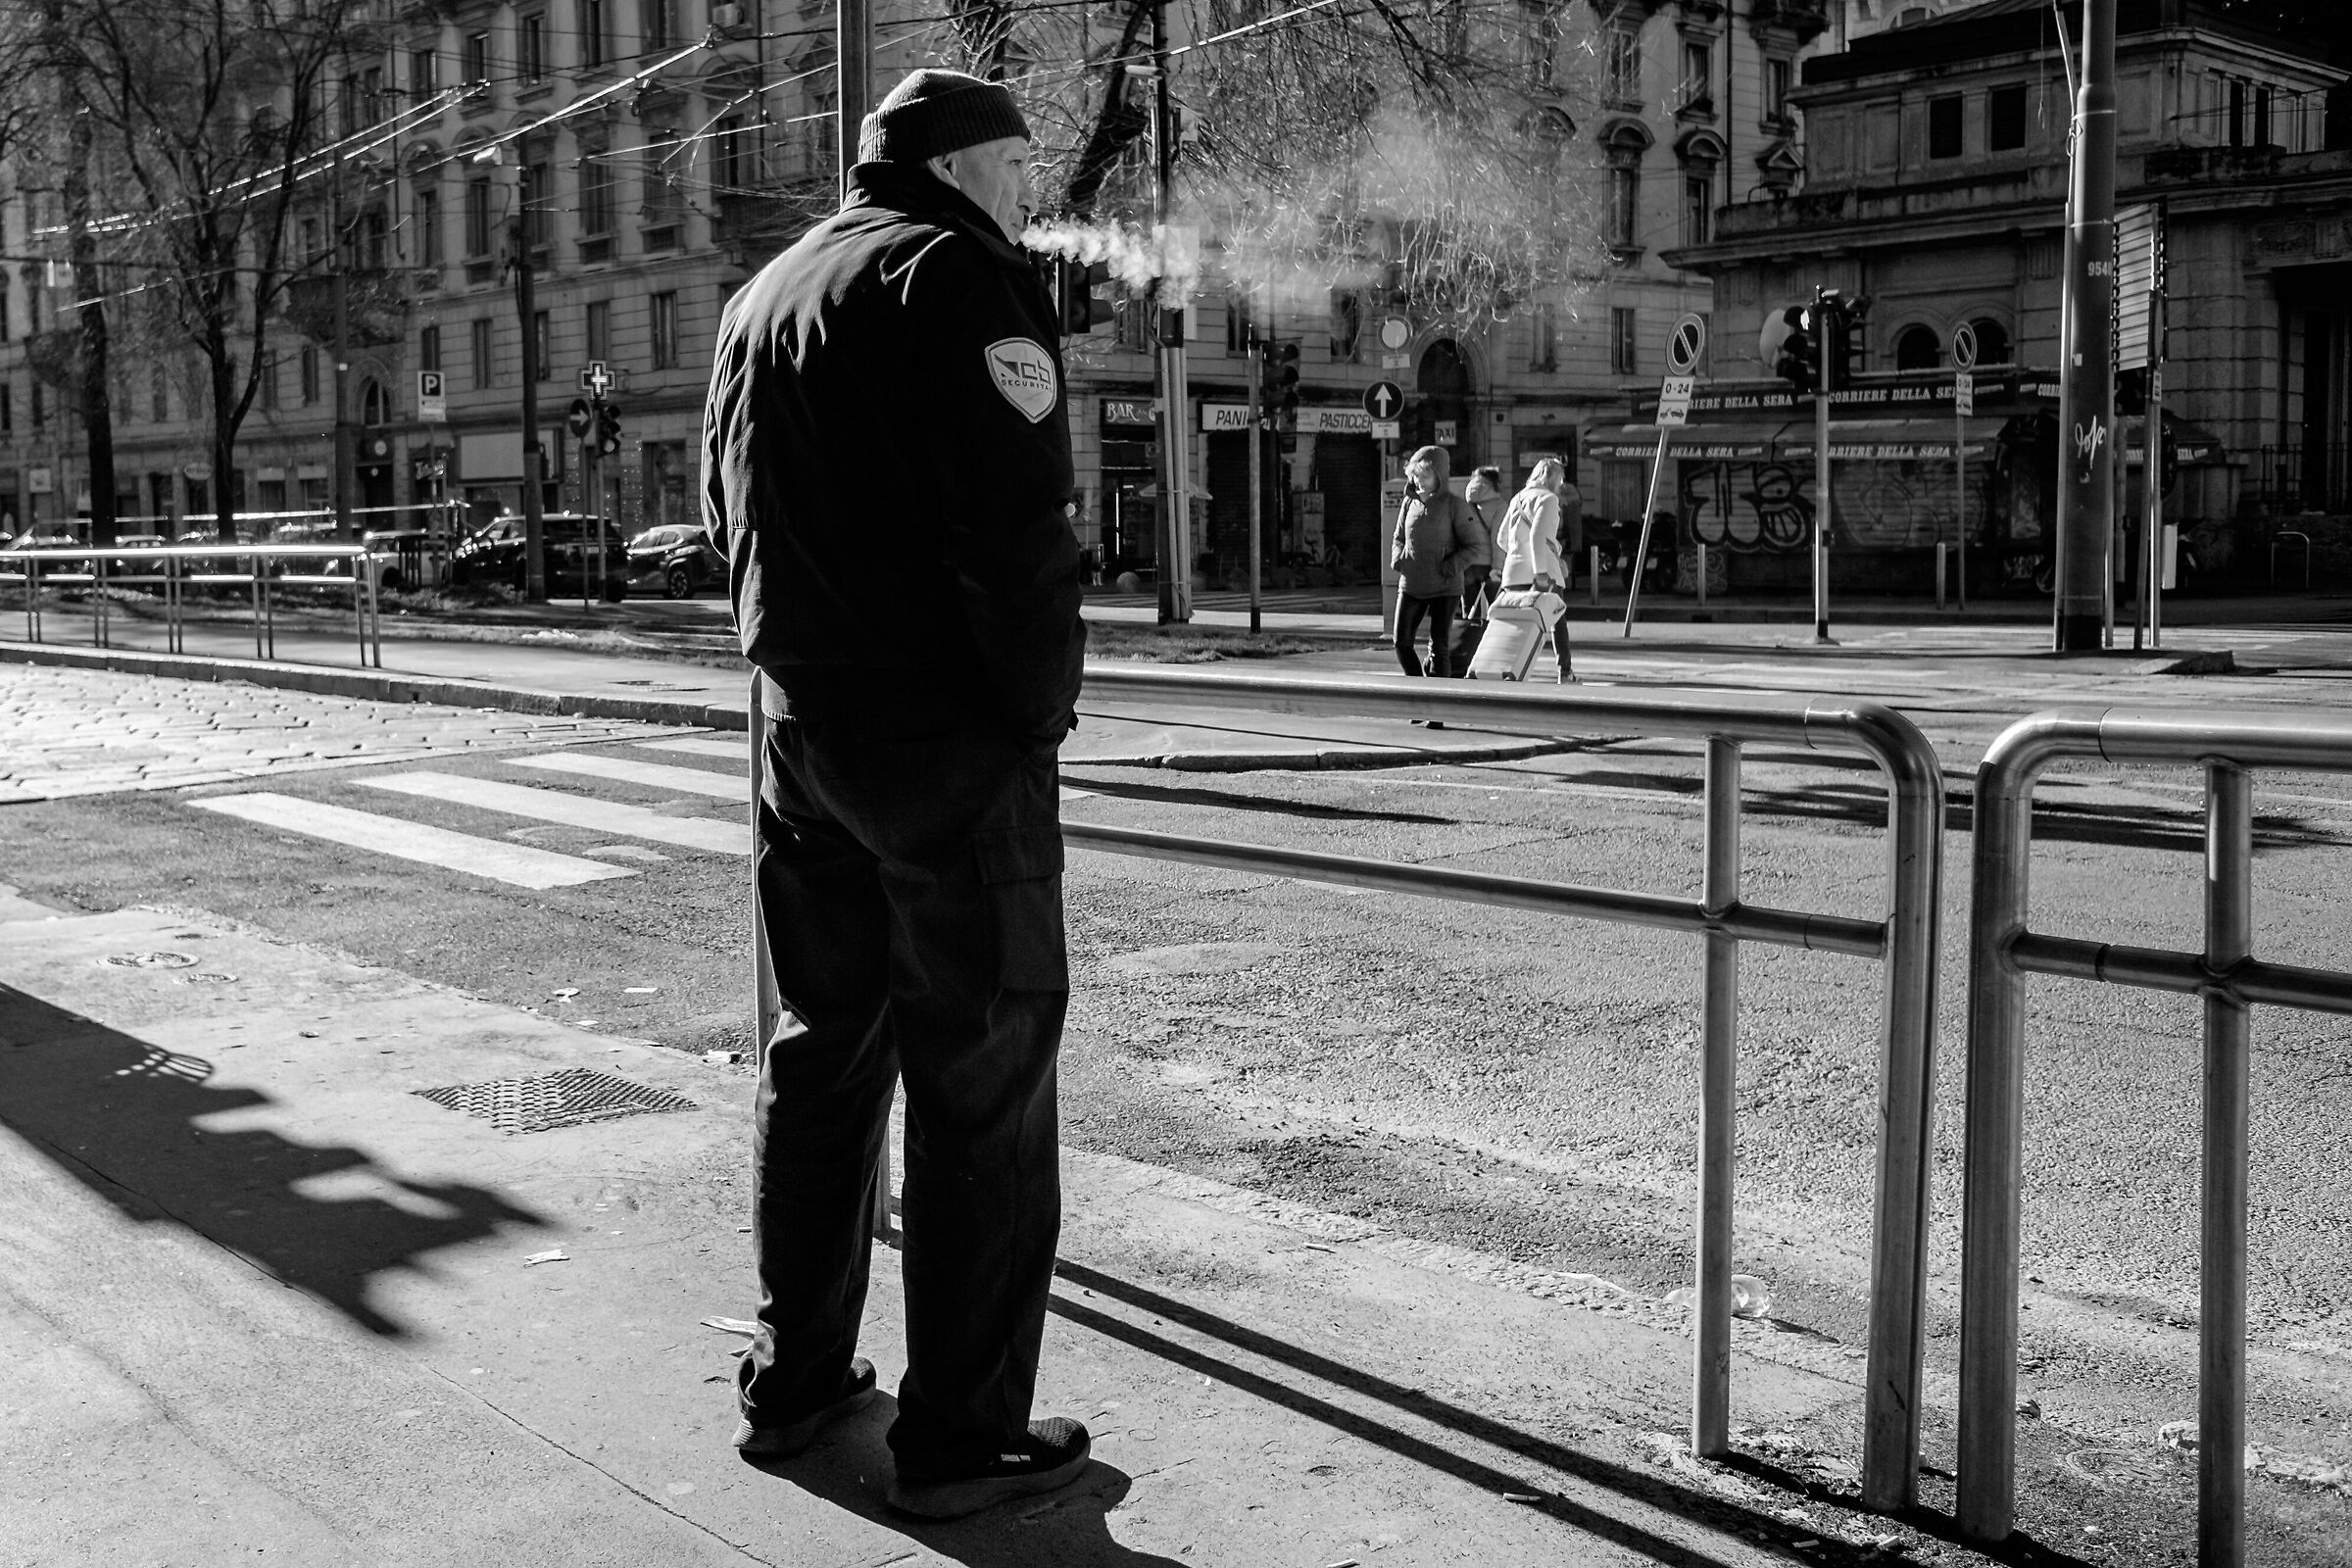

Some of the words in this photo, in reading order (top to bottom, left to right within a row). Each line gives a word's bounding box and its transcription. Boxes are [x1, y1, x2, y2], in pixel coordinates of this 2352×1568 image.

[425, 374, 439, 394] P
[1688, 397, 1721, 410] RIERE
[1724, 396, 1759, 409] DELLA
[1763, 394, 1793, 407] SERA
[1828, 389, 1887, 404] CORRIERE
[1891, 387, 1931, 401] DELLA
[1936, 385, 1956, 399] SE
[1105, 403, 1141, 422] BAR
[1435, 427, 1455, 439] TAXI
[1615, 446, 1659, 458] CORRIE
[1669, 446, 1702, 458] DELLA
[1705, 446, 1734, 458] SERA
[1827, 445, 1874, 458] RRIERE
[1876, 445, 1914, 458] DELLA
[1919, 445, 1951, 458] SERA
